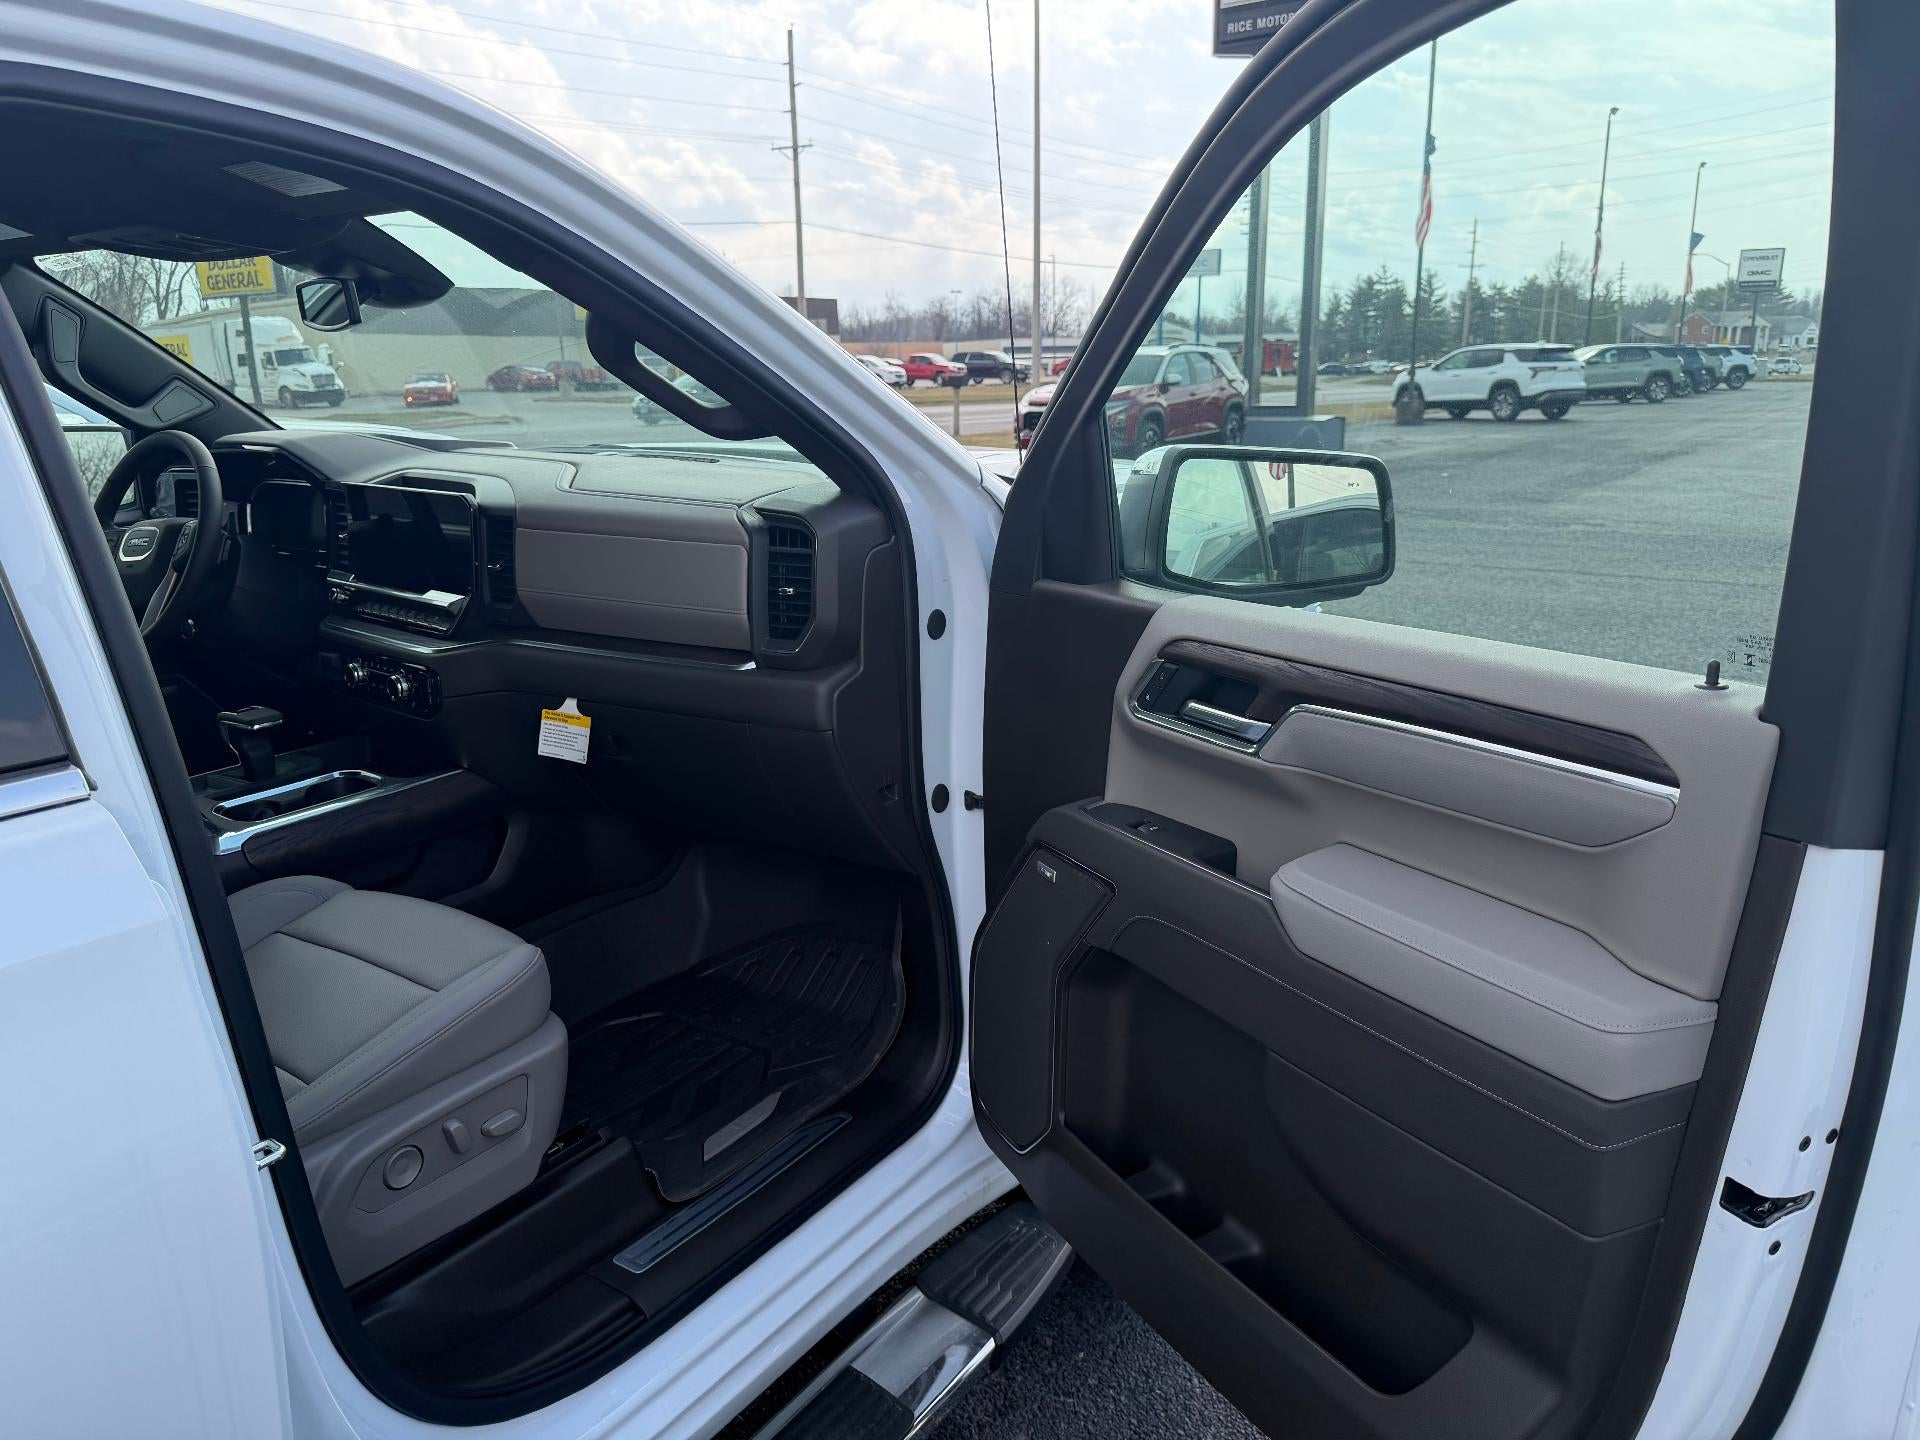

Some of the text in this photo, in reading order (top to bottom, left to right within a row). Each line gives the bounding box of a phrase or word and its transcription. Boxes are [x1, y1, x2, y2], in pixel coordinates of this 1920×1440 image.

[1227, 19, 1253, 34] RICE
[208, 257, 256, 271] DOLLAR
[207, 270, 263, 291] GENERAL
[127, 537, 150, 547] GMC
